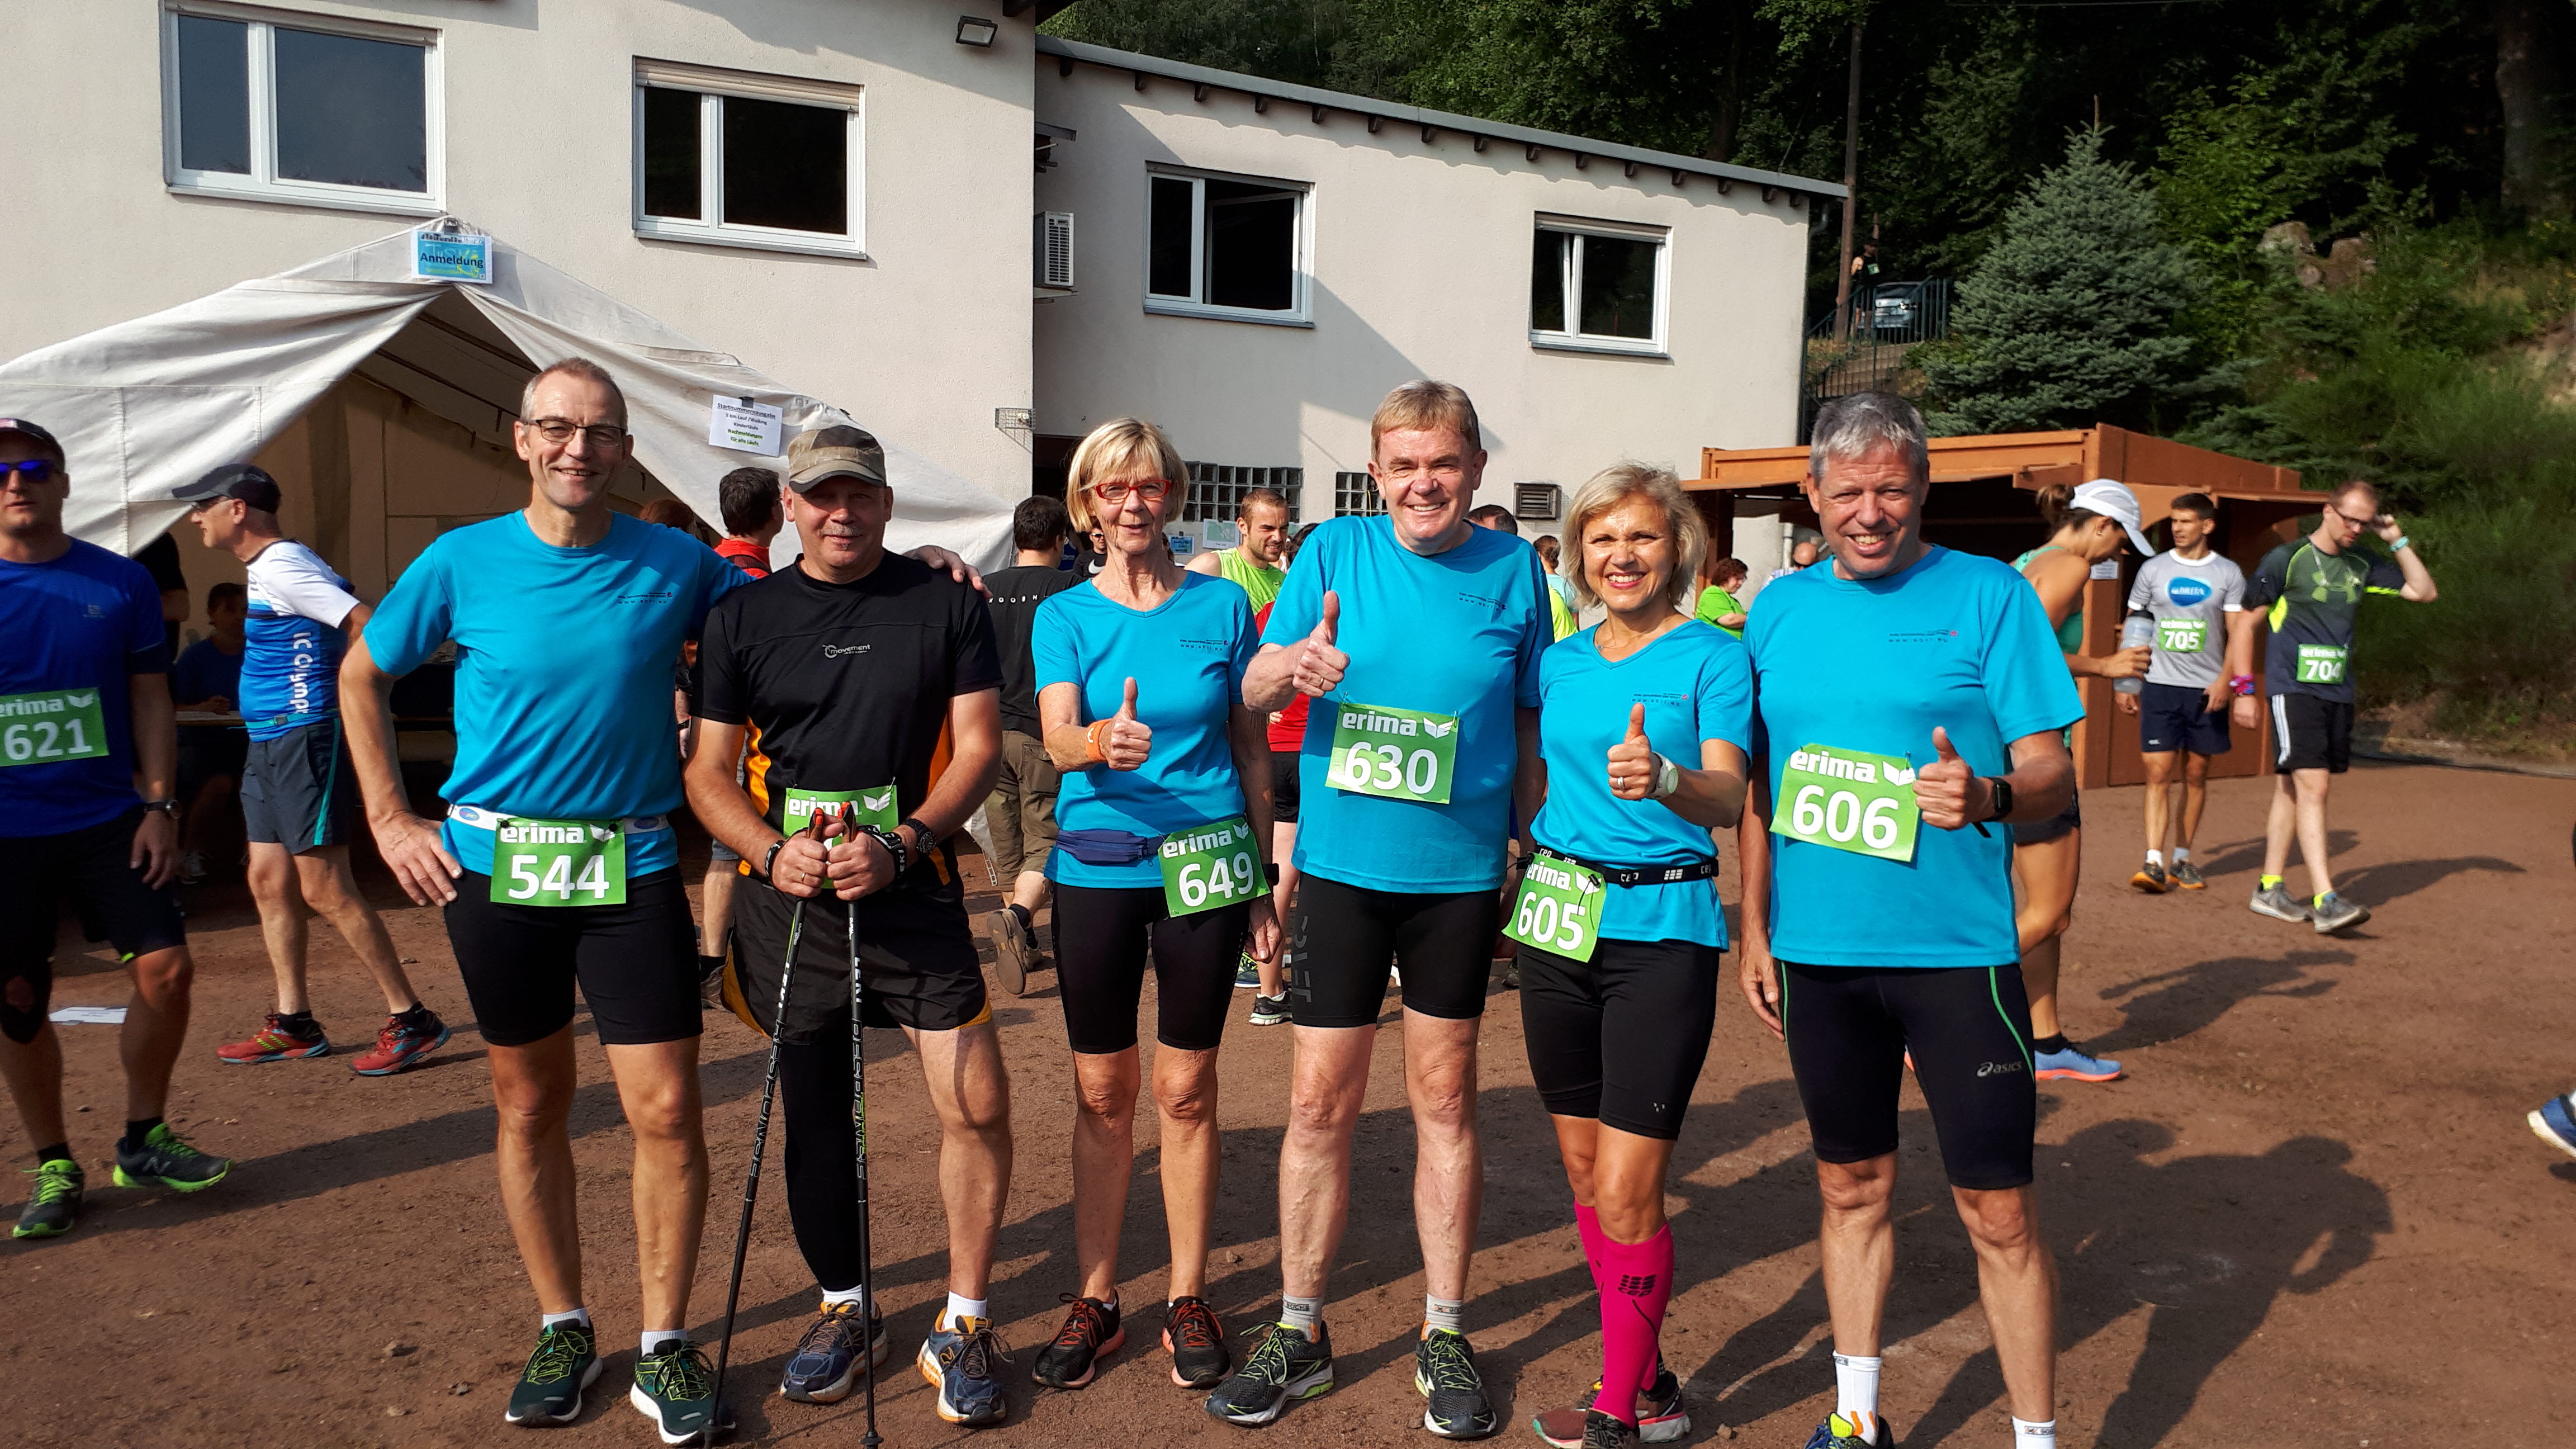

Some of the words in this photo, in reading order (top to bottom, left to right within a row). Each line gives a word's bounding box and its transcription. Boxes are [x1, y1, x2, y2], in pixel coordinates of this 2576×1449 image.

[420, 253, 484, 269] Anmeldung
[830, 644, 871, 654] movement
[2163, 631, 2201, 649] 705
[2305, 660, 2342, 680] 704
[1342, 711, 1417, 737] erima
[4, 718, 93, 761] 621
[1344, 741, 1438, 794] 630
[1789, 750, 1876, 783] erima
[1792, 784, 1899, 849] 606
[500, 822, 584, 844] erima
[1163, 830, 1232, 859] erima
[508, 854, 610, 900] 544
[1178, 851, 1254, 907] 649
[1526, 860, 1571, 890] erima
[1700, 864, 1712, 875] cep
[1517, 891, 1587, 951] 605
[854, 956, 863, 1003] LEKI
[1993, 1061, 2023, 1072] asics
[1617, 1286, 1653, 1297] cep
